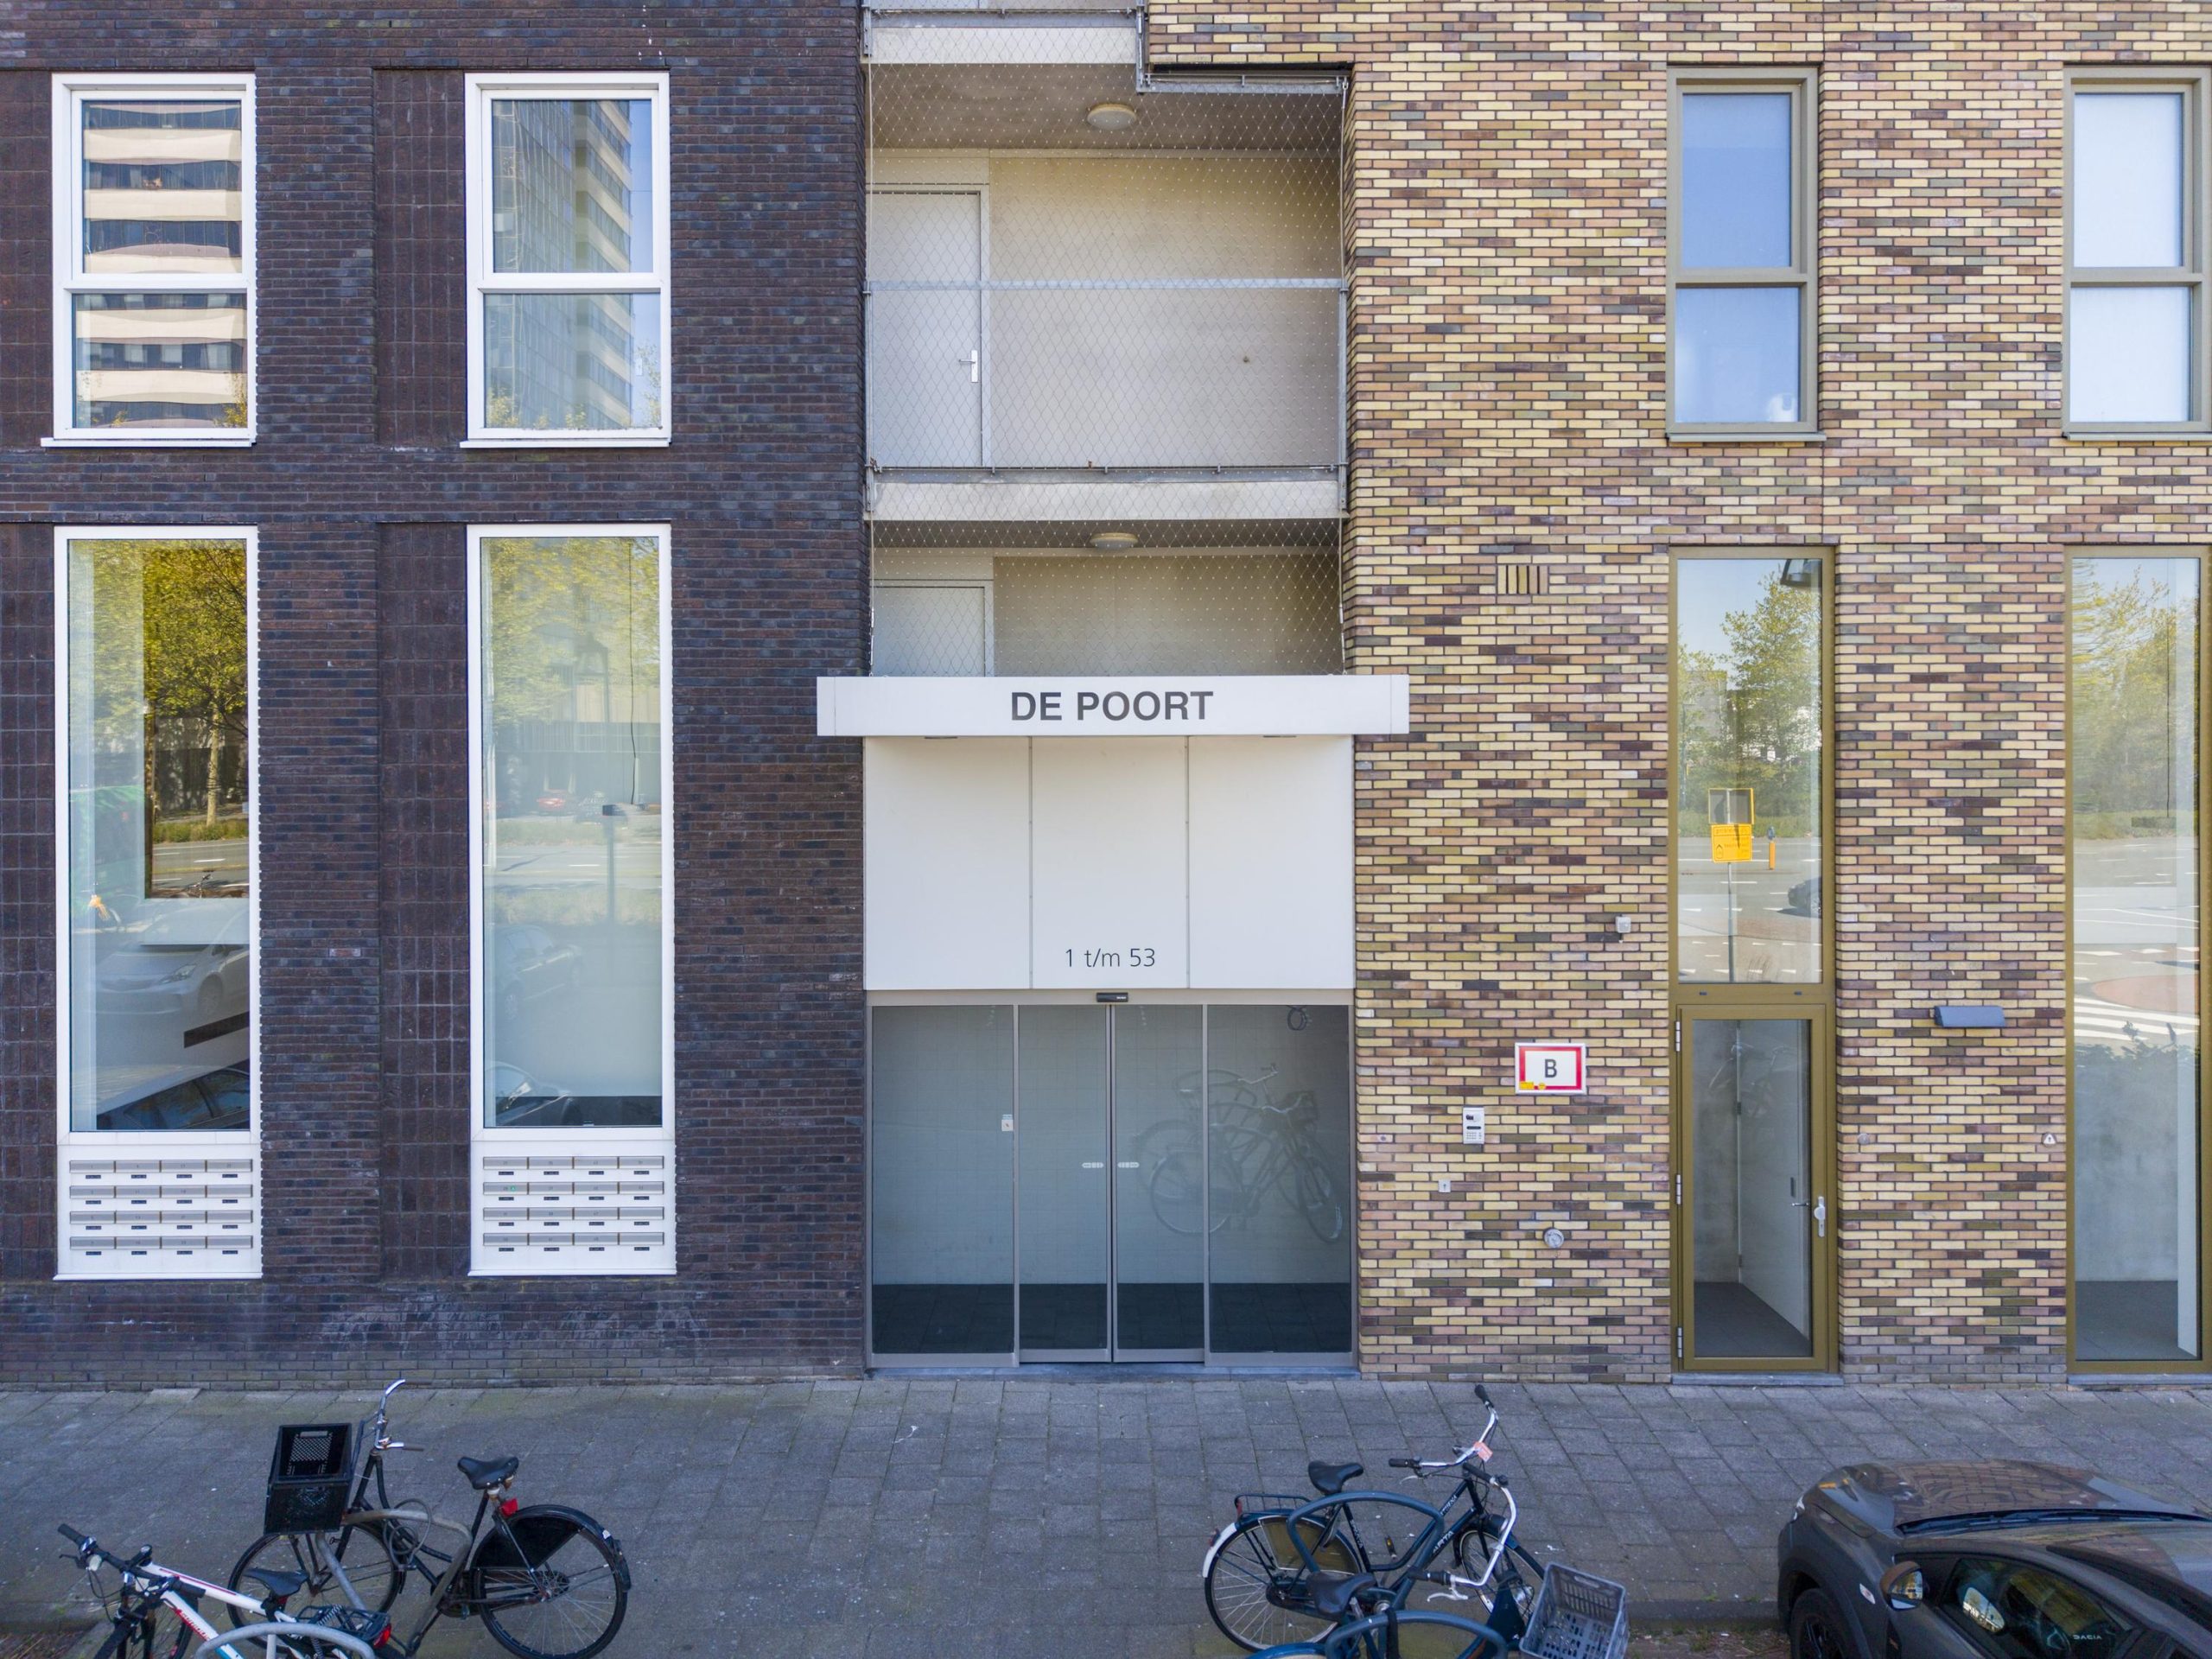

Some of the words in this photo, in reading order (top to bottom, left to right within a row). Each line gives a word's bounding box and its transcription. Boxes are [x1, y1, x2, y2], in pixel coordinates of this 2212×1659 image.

[1012, 692, 1062, 721] DE
[1077, 691, 1213, 721] POORT
[1065, 949, 1073, 967] 1
[1084, 948, 1120, 967] t/m
[1130, 948, 1155, 967] 53
[1544, 1058, 1558, 1078] B
